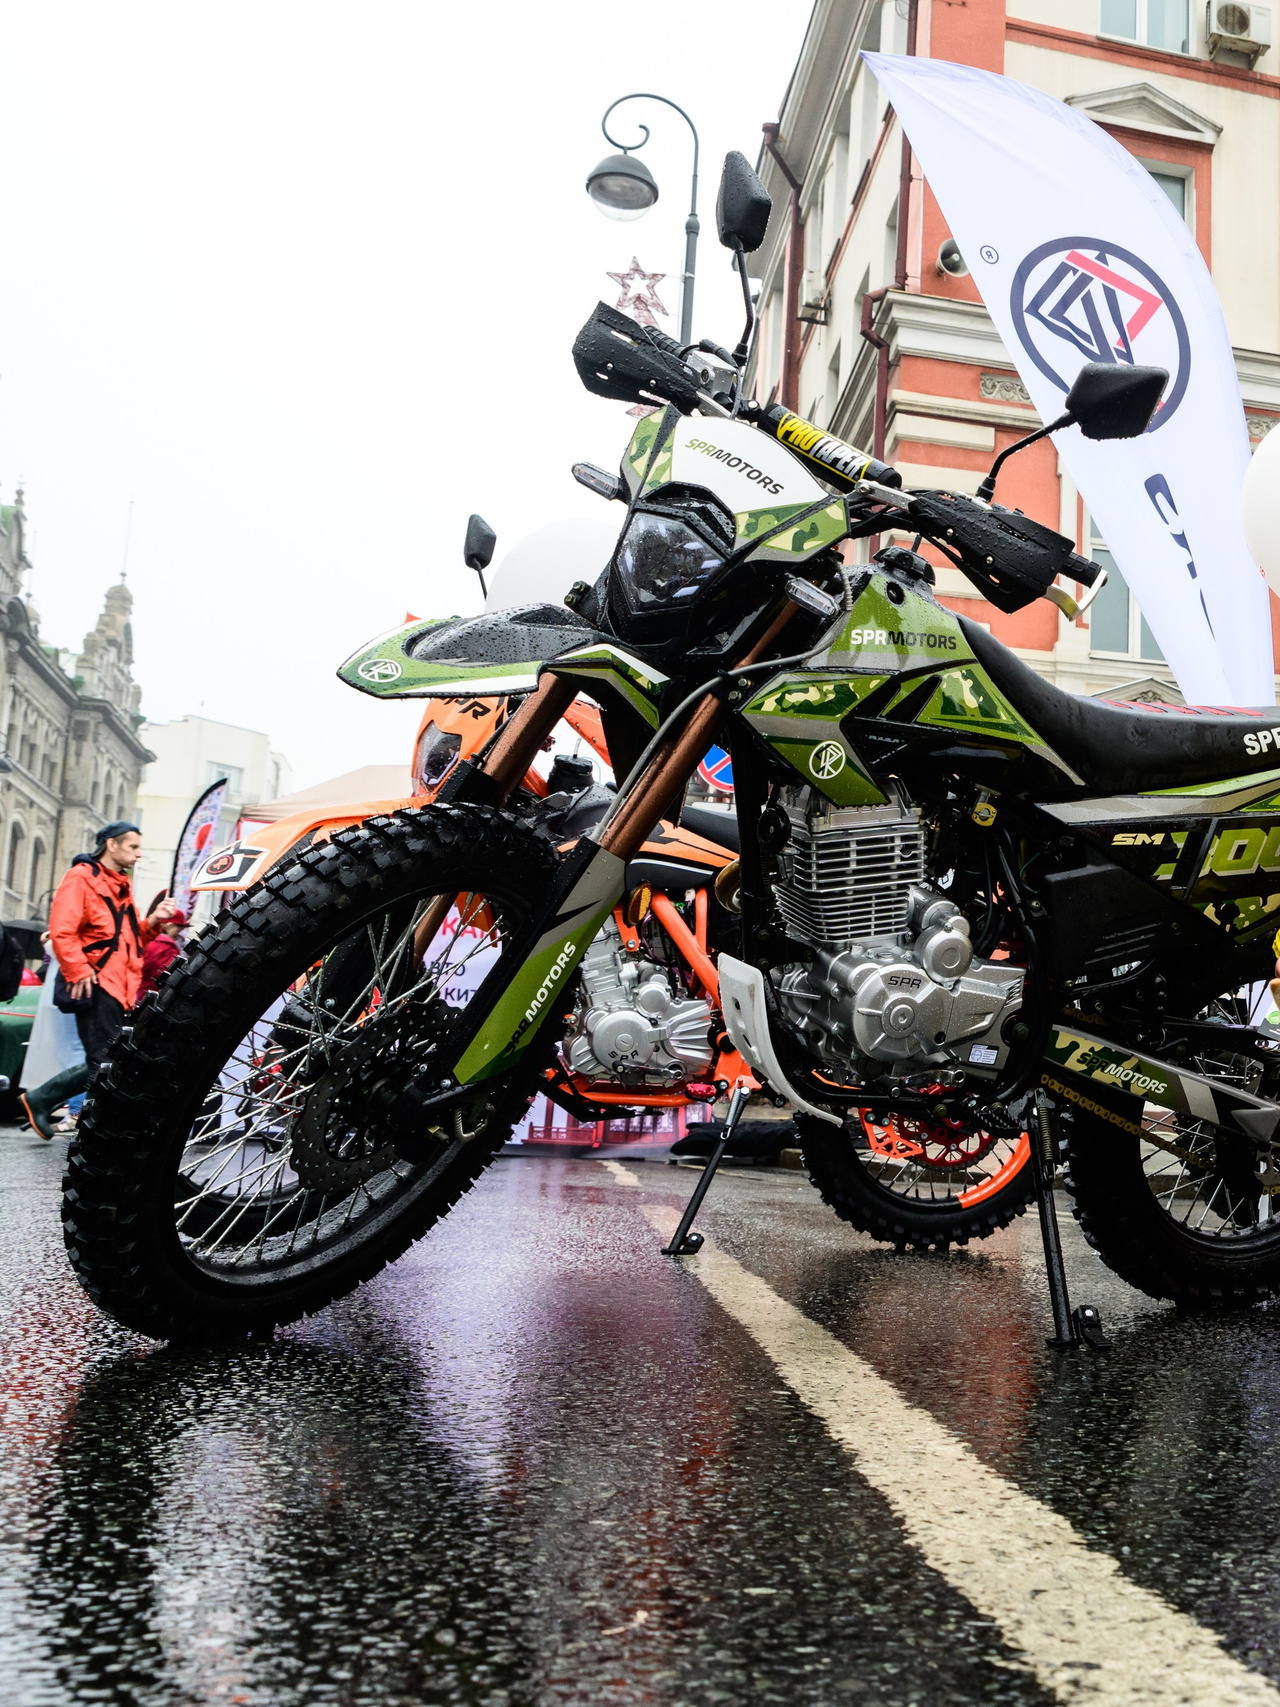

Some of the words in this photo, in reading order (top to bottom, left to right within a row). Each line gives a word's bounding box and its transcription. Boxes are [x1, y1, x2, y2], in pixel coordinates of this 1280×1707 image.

[782, 417, 870, 478] PROTAPER
[685, 438, 785, 495] SPRMOTORS
[850, 629, 957, 650] SPRMOTORS
[1111, 833, 1166, 845] SM
[888, 975, 922, 989] SPR
[1076, 1052, 1168, 1094] SPRMOTORS
